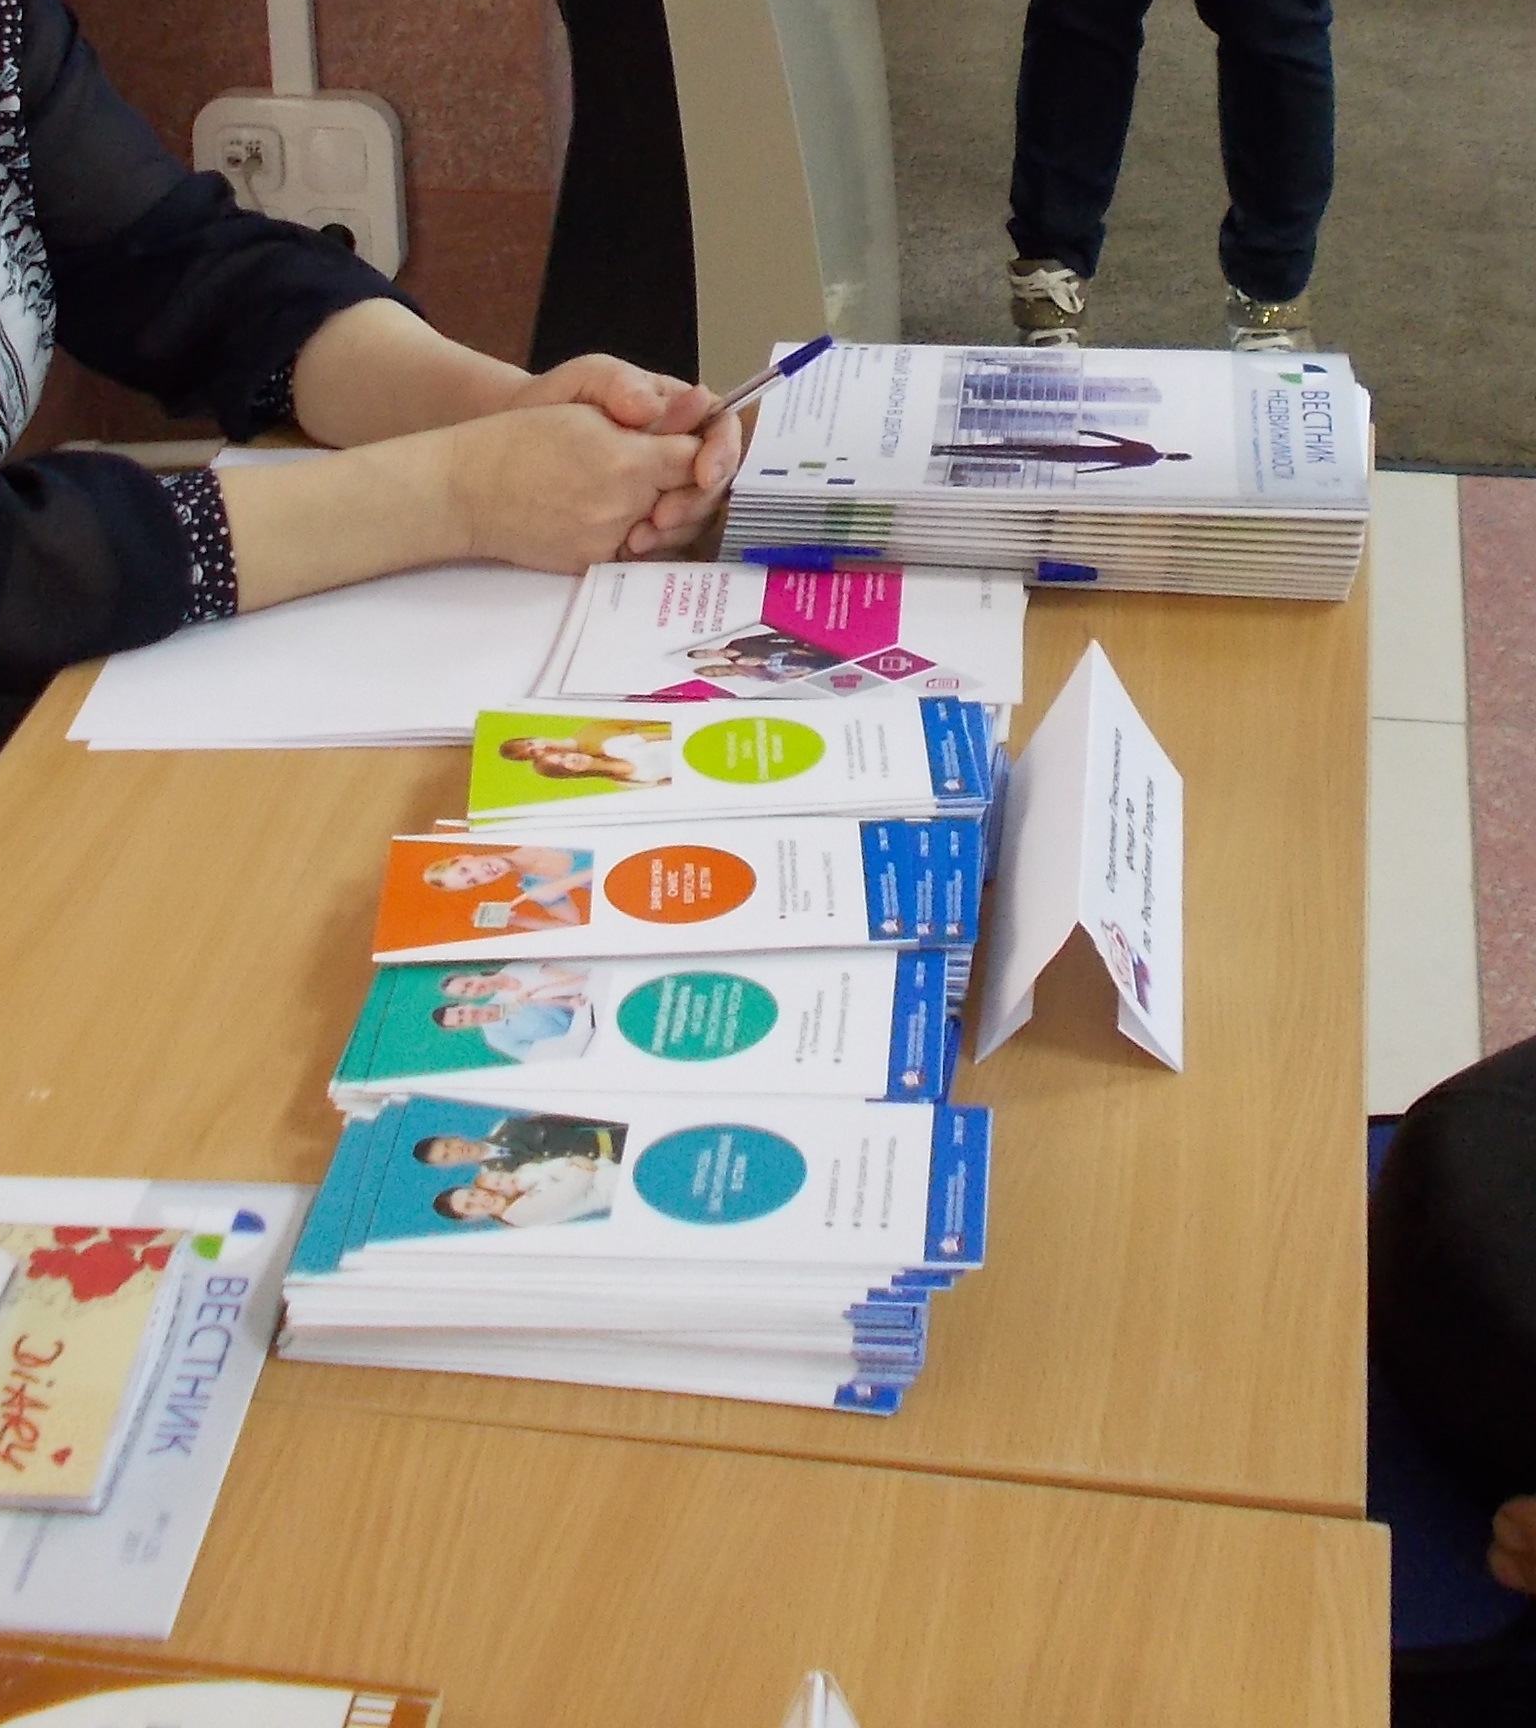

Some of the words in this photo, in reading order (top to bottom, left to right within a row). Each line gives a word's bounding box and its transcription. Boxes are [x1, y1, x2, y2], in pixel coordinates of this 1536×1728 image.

[887, 409, 904, 417] В
[888, 376, 908, 408] ЗАКОН
[1264, 389, 1295, 480] НЕДВИЖИМОСТИ
[1301, 390, 1337, 464] ВЕСТНИК
[655, 572, 677, 627] МАТЕРИНСКИЙ
[676, 581, 691, 616] КАПИТАЛ
[695, 572, 714, 618] СЕМЕЙНОГО
[710, 571, 730, 633] БЛАГОПОЛУЧИЯ
[1107, 726, 1123, 811] Пенсионного
[1105, 815, 1120, 894] Отделение
[1124, 823, 1137, 873] фонда
[1140, 843, 1155, 928] Республике
[1141, 930, 1152, 954] по
[147, 1274, 251, 1459] ВЕСТНИК
